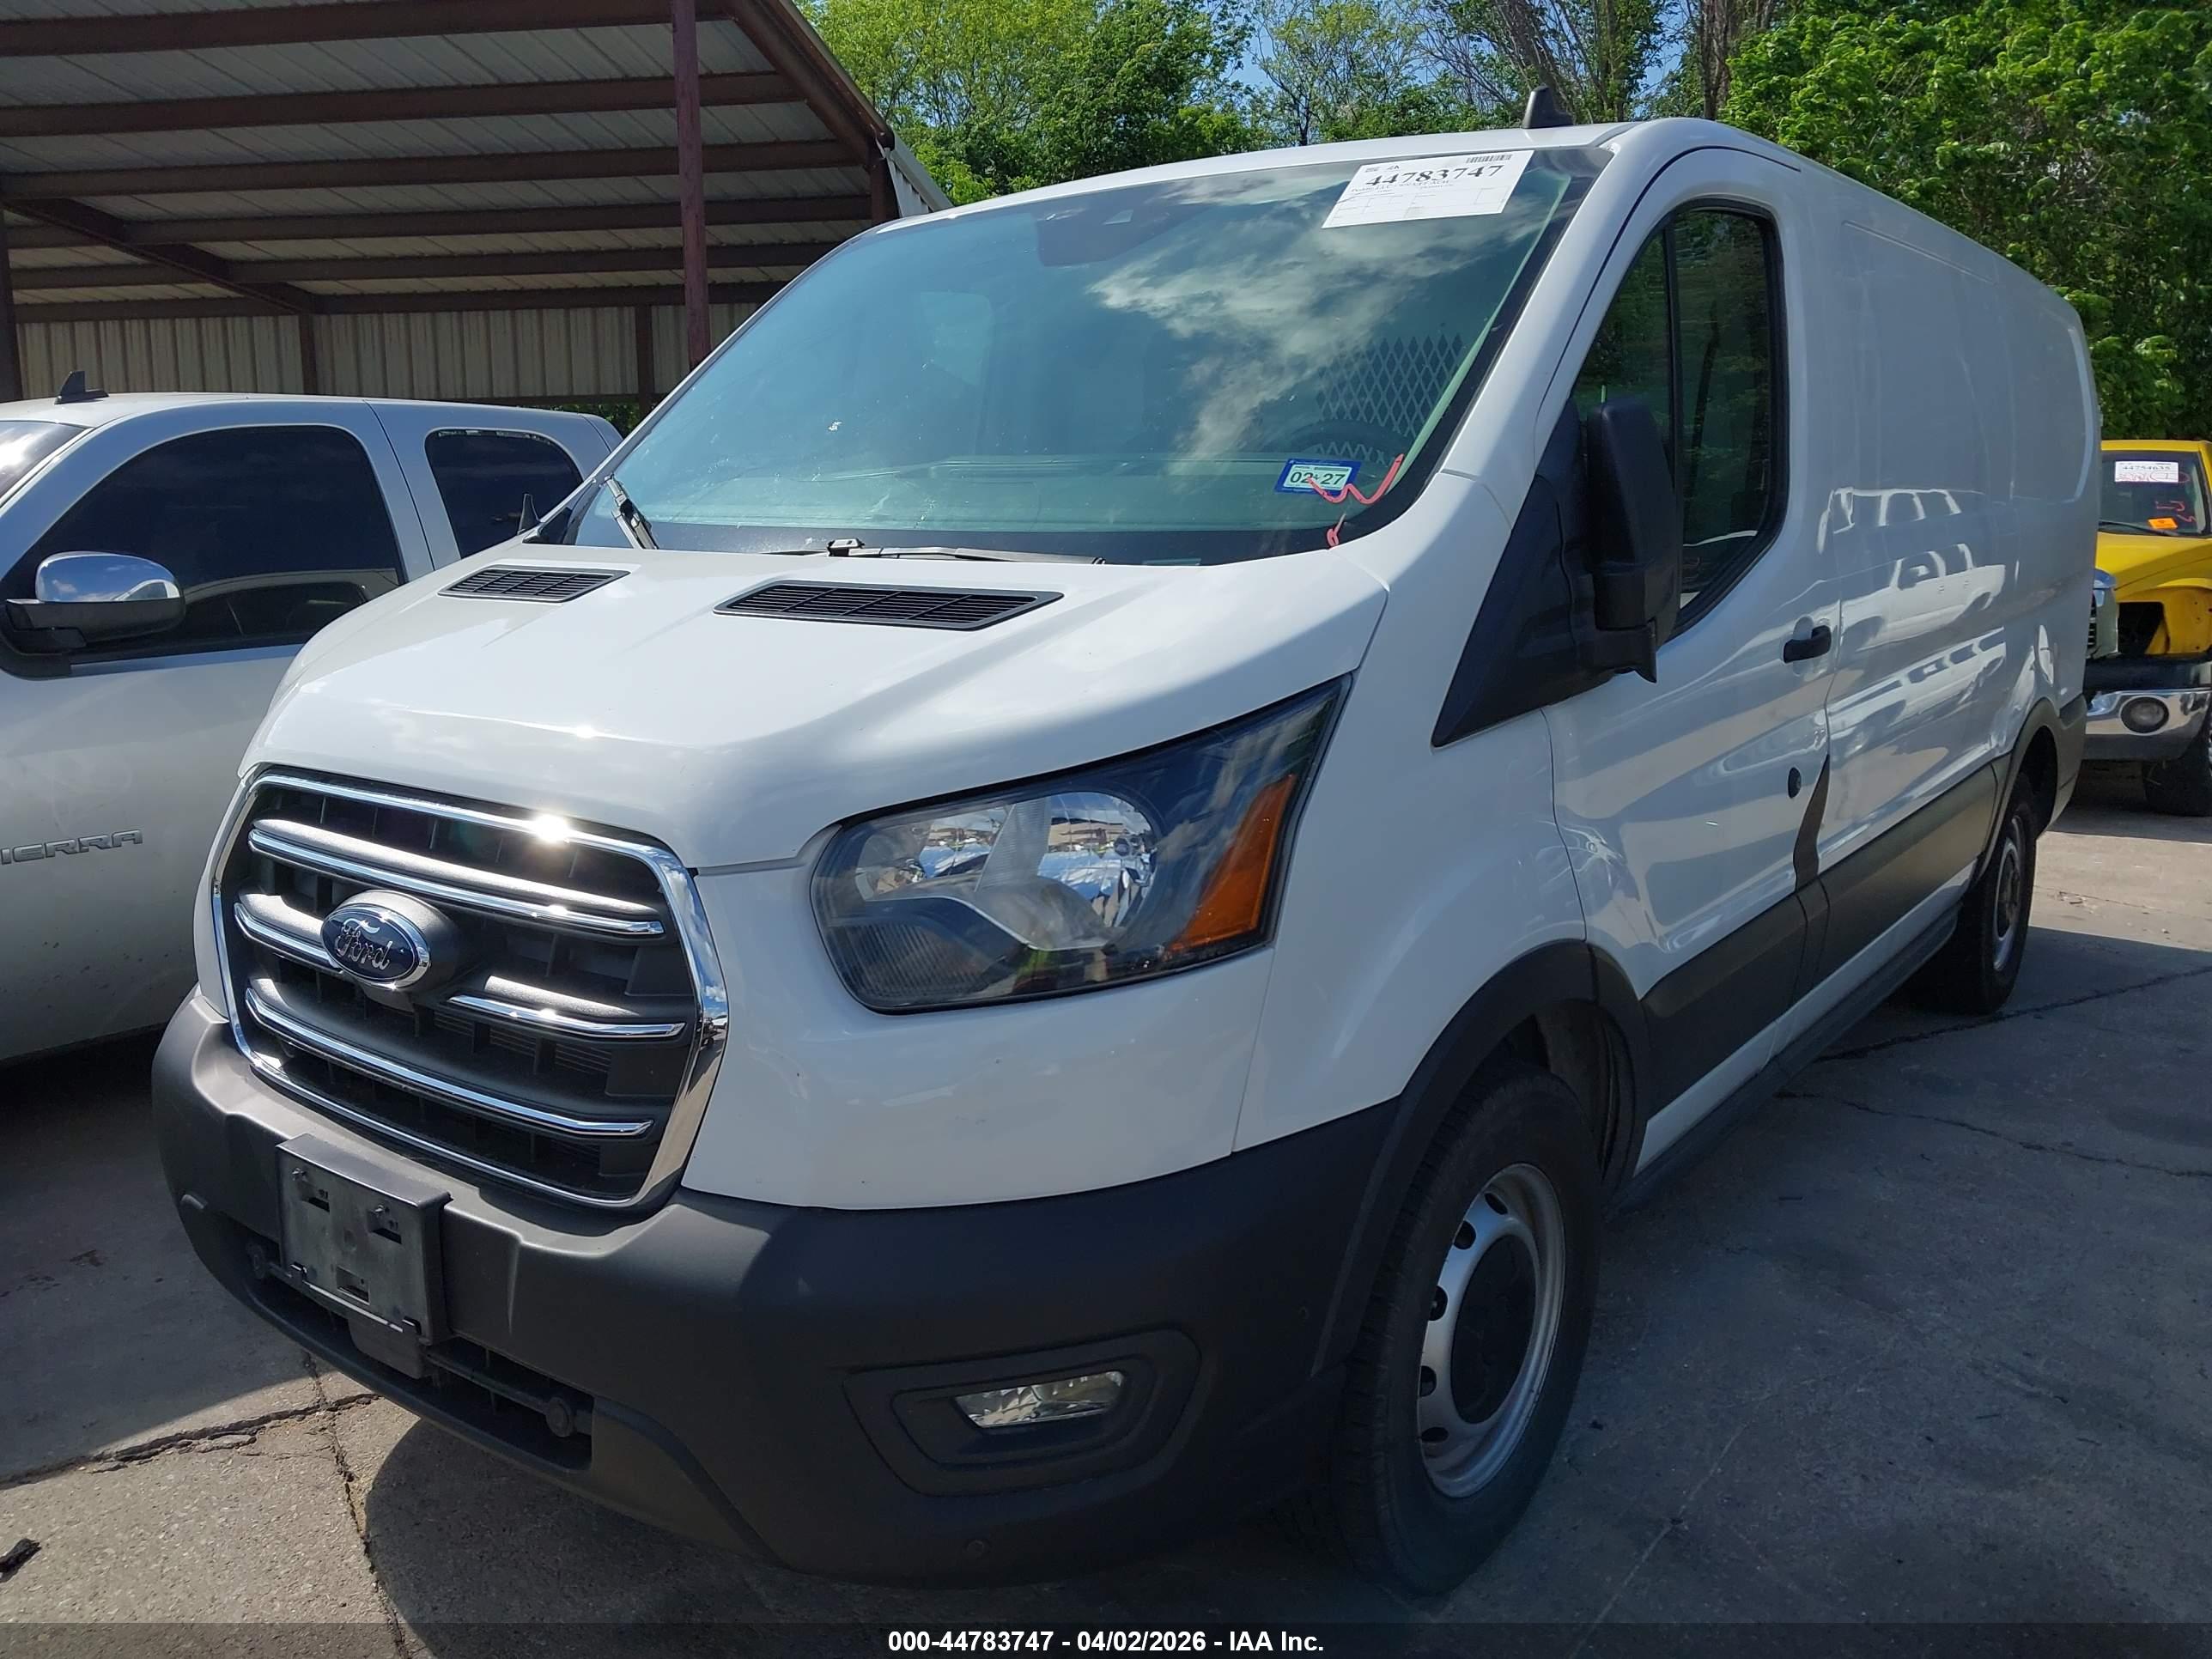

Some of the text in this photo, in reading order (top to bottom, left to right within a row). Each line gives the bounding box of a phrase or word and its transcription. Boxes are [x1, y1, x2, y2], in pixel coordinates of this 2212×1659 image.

[1366, 166, 1503, 186] 44783747
[1321, 473, 1346, 485] 27
[1, 829, 143, 865] IERRA
[335, 918, 393, 970] Ford
